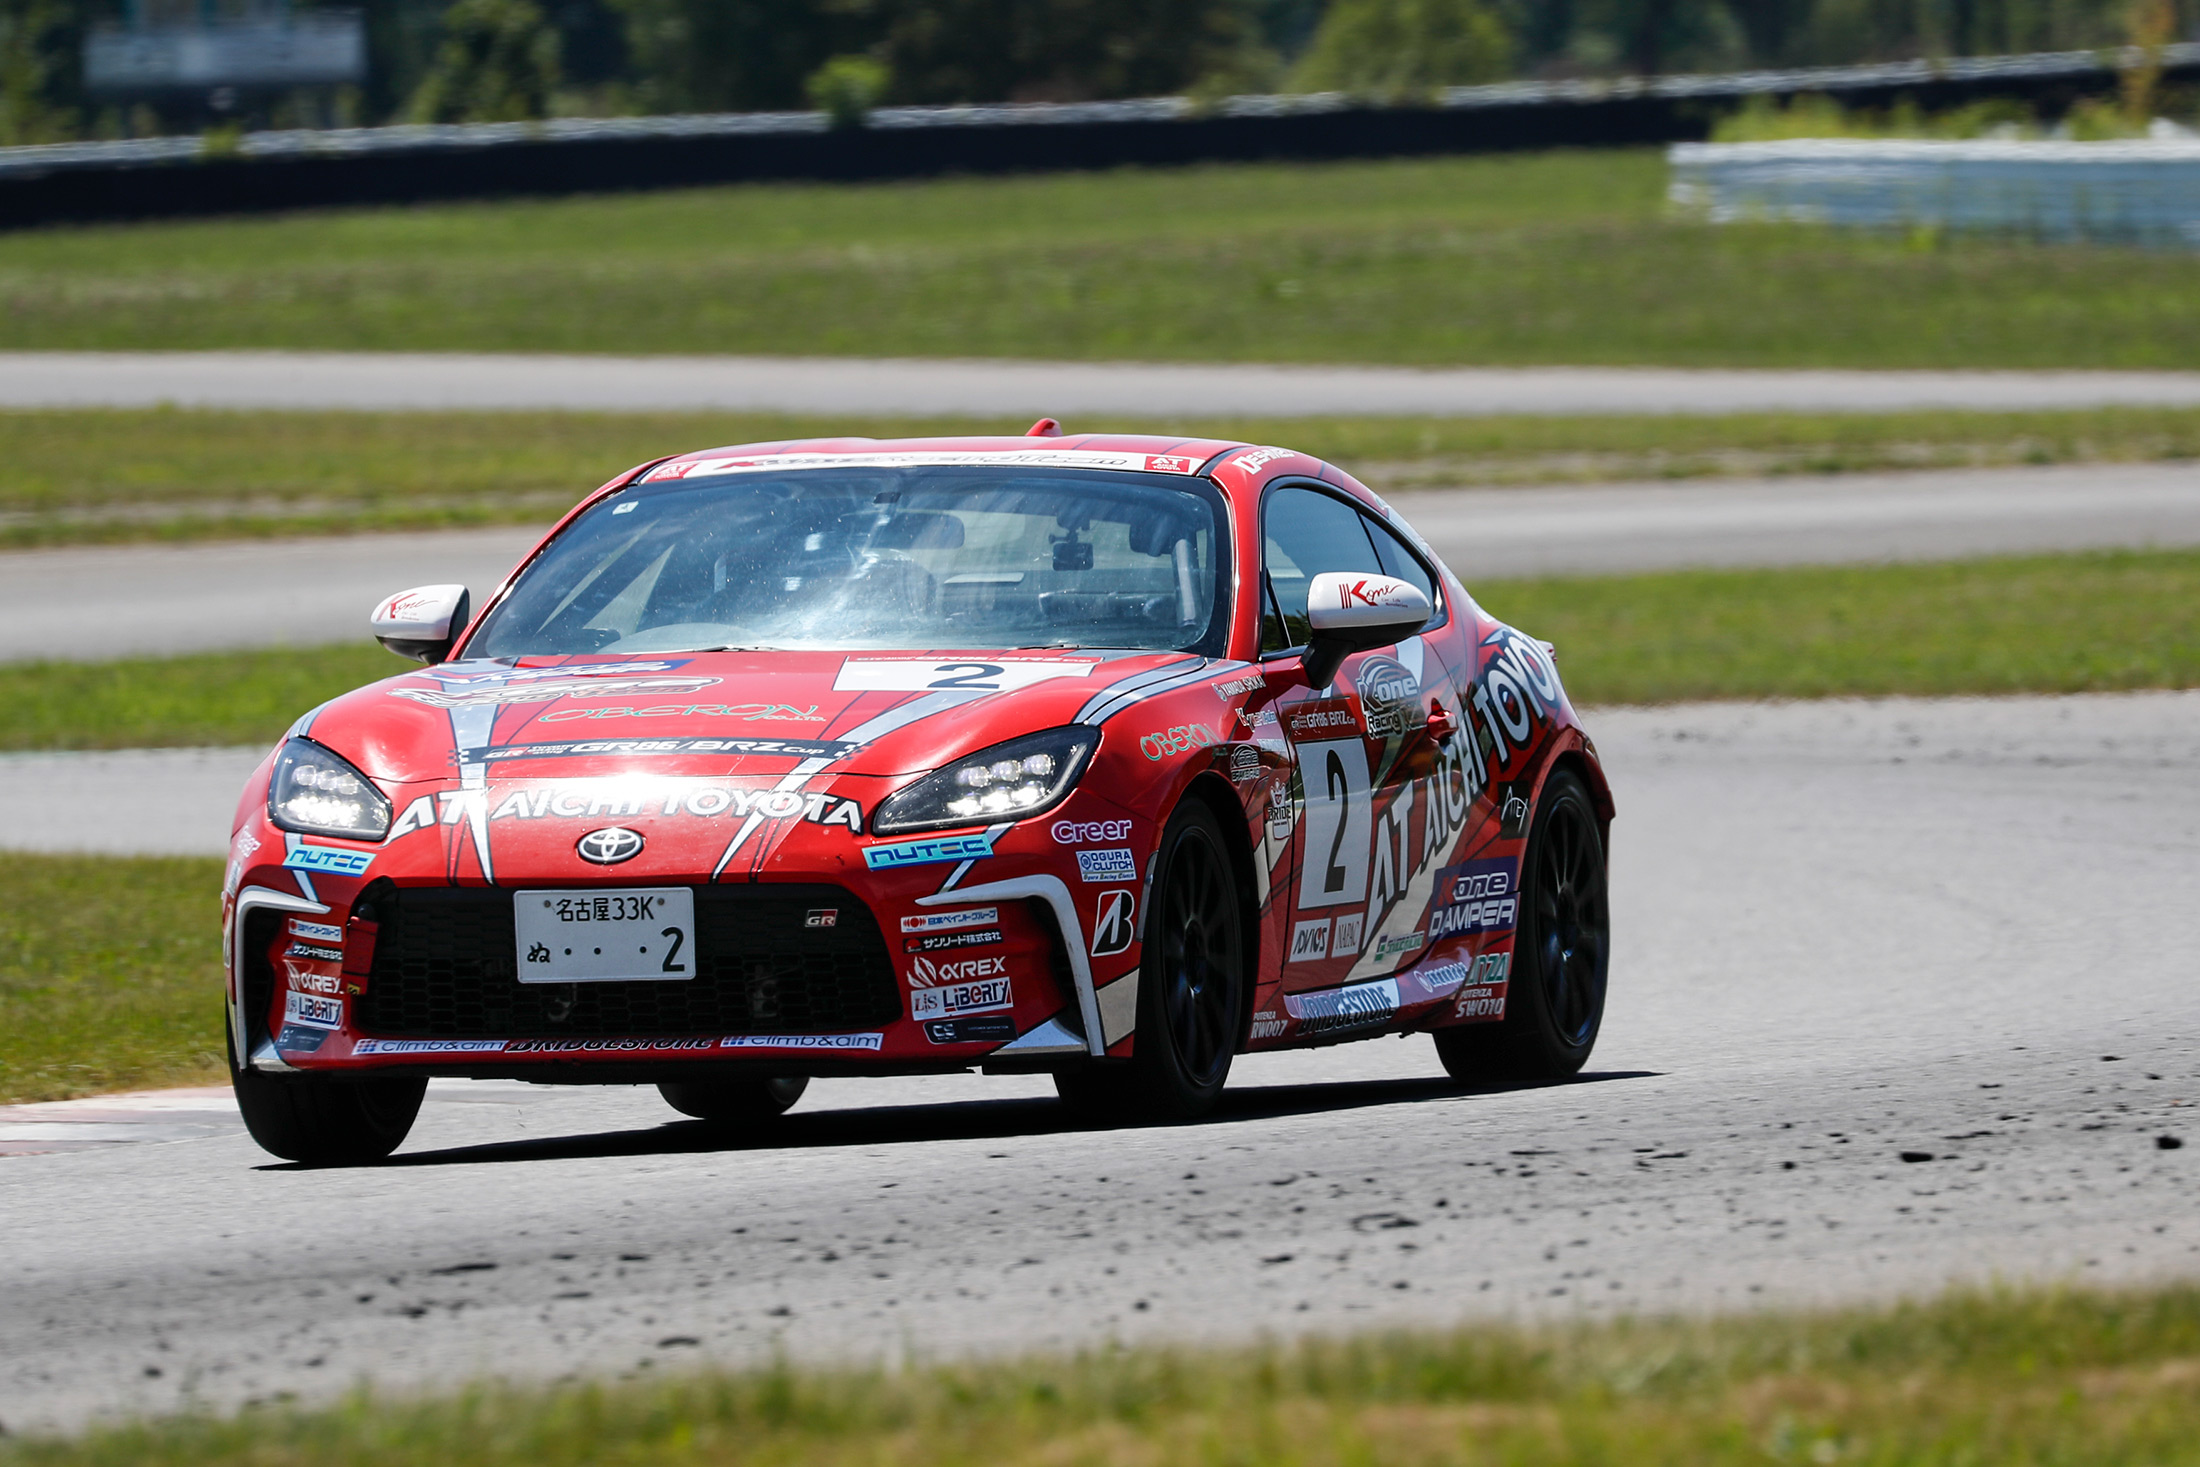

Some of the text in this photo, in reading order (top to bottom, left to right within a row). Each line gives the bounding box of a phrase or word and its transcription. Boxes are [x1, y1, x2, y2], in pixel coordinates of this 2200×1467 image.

[927, 664, 1005, 689] 2
[538, 704, 818, 721] OBERON
[782, 746, 825, 755] Cup
[1140, 723, 1222, 761] OBERON
[378, 786, 864, 847] AT AICHI TOYOTA
[1268, 805, 1291, 820] BRIDE
[1324, 749, 1349, 893] 2
[1051, 819, 1132, 844] Creer
[1362, 779, 1414, 950] AT
[1424, 710, 1487, 862] AICHI
[1091, 851, 1131, 861] OGURA
[1093, 860, 1133, 871] CLUTCH
[556, 898, 610, 921] 名古屋
[1429, 899, 1515, 937] DAMPER
[808, 916, 834, 925] GR
[527, 927, 685, 972] ぬ 2
[1253, 1010, 1277, 1021] POTENZA
[1251, 1020, 1288, 1039] RW007
[382, 1040, 505, 1052] climb&aim
[751, 1035, 880, 1048] climb&aim
